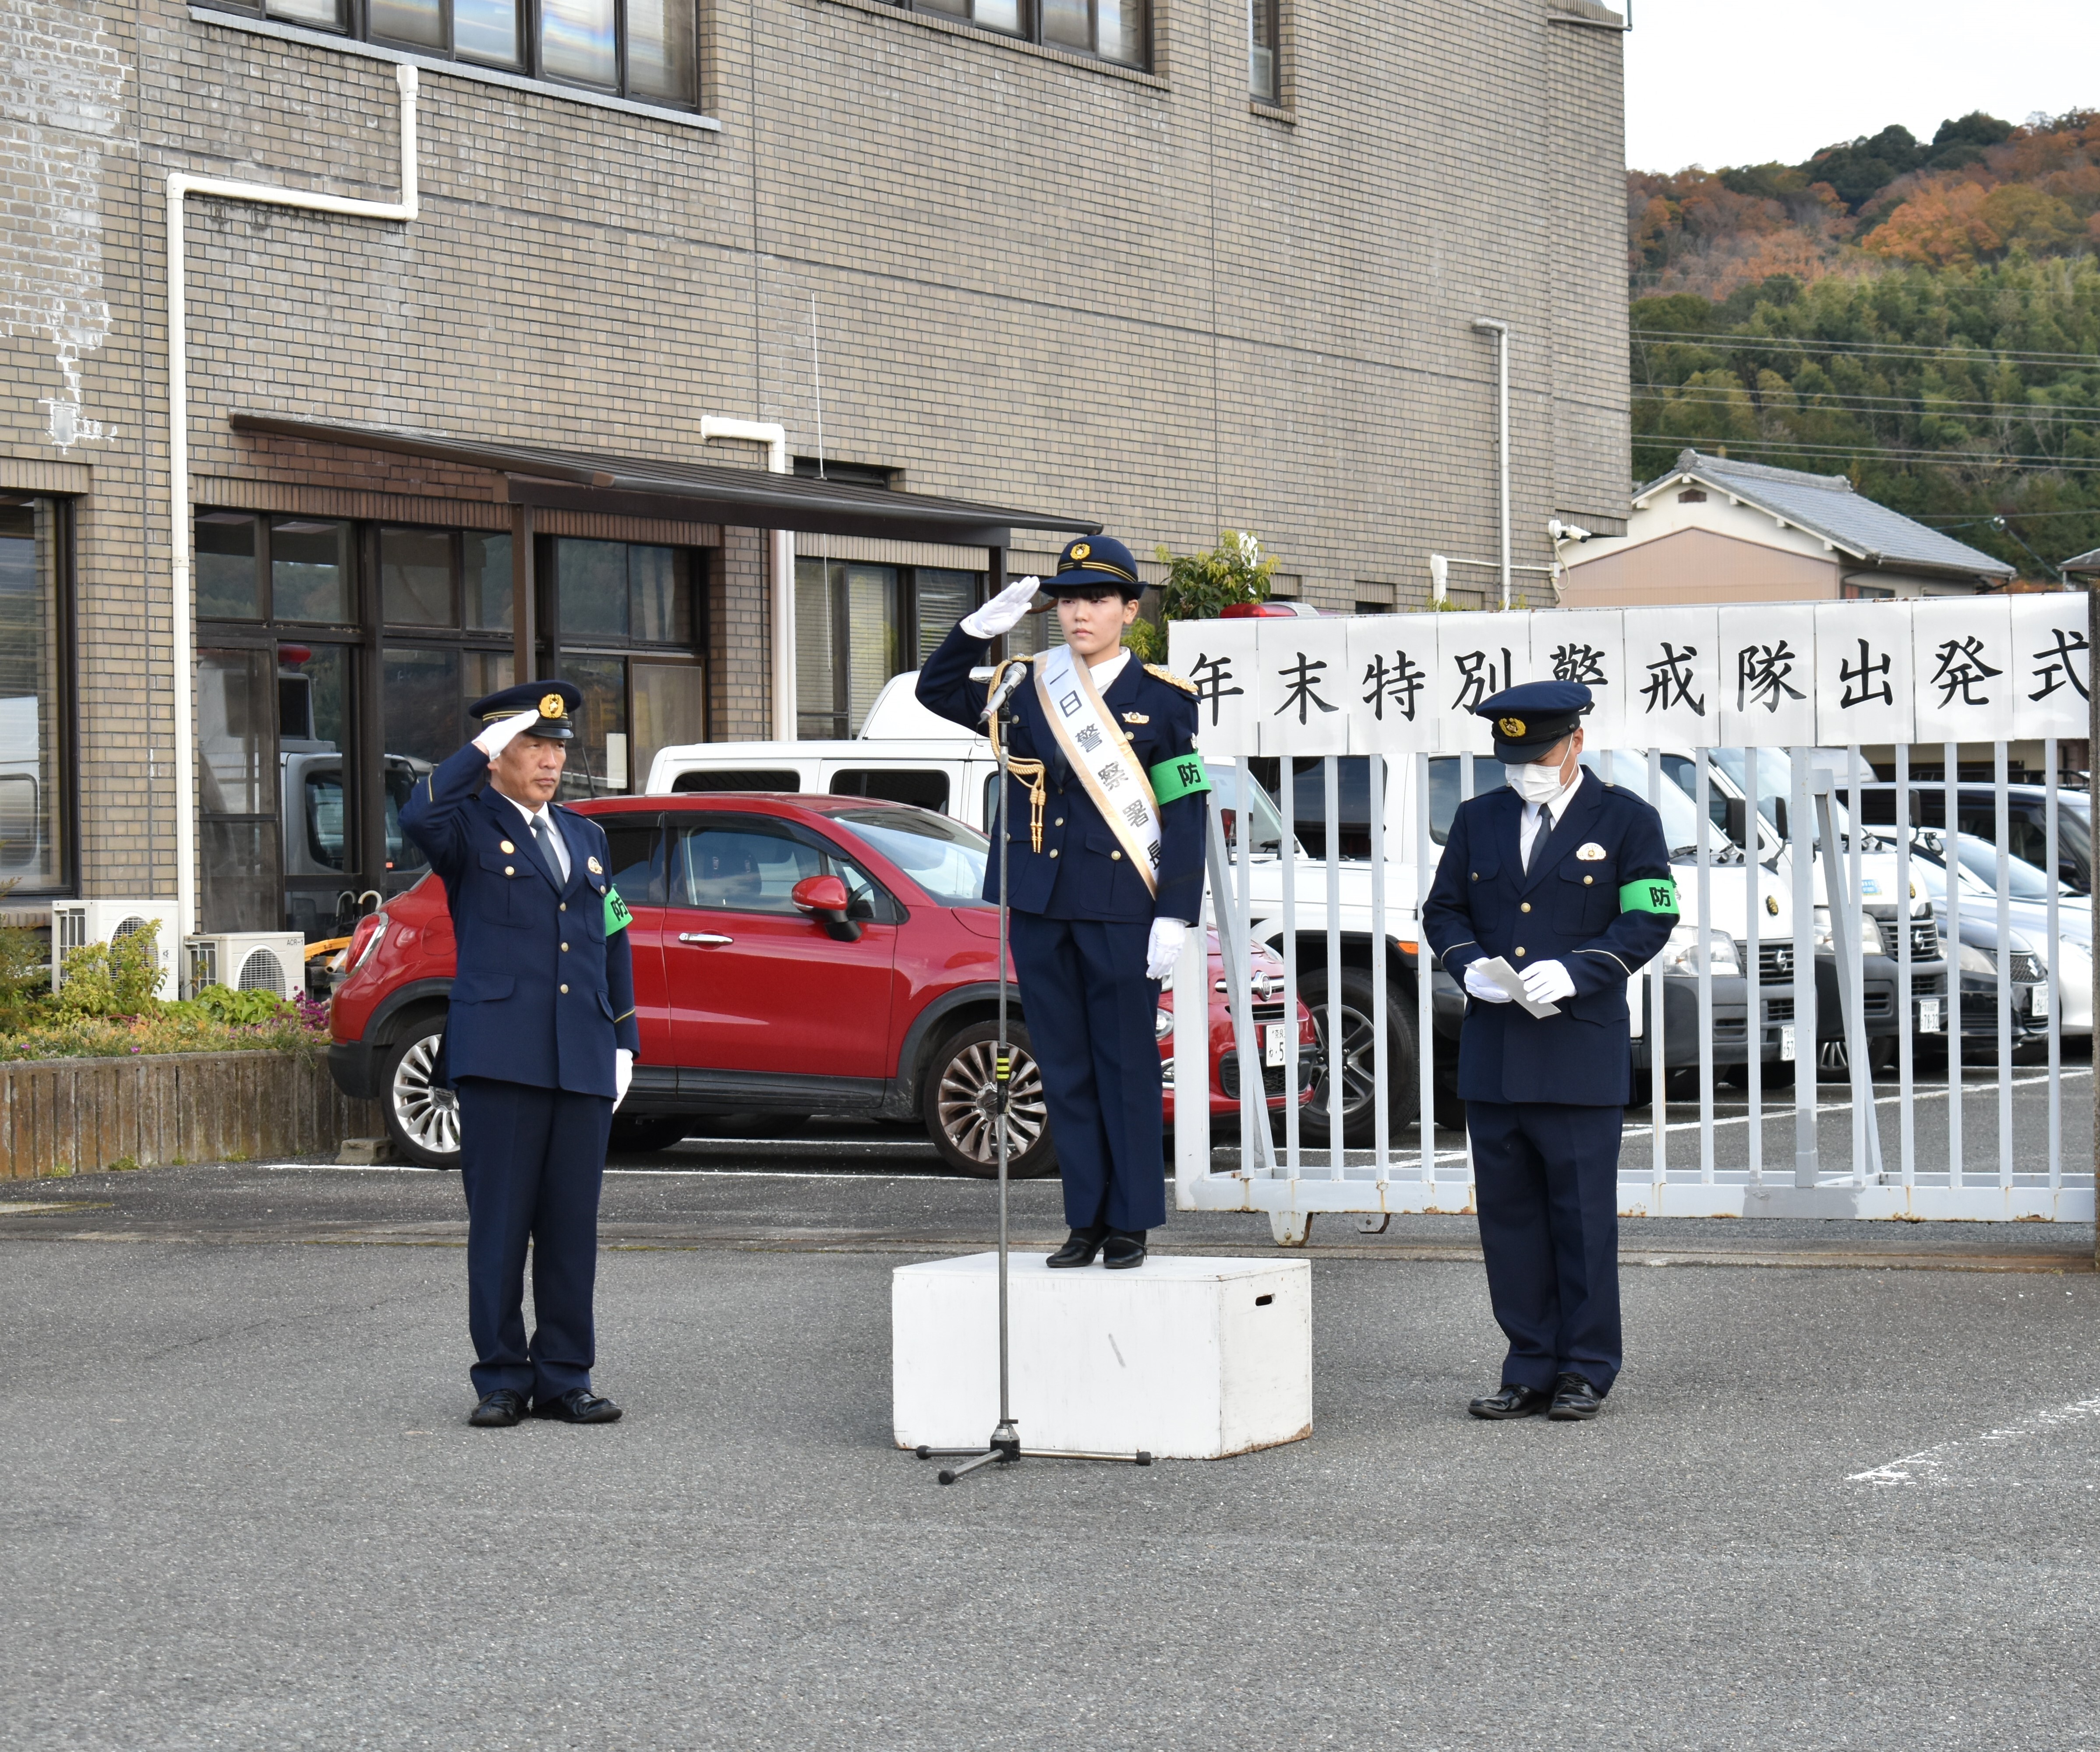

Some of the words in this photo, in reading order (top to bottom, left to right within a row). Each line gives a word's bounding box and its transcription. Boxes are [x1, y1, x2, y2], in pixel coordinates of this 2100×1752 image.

[1177, 762, 1201, 788] 防
[610, 896, 628, 922] 防
[1648, 886, 1671, 908] 防
[1275, 1028, 1285, 1038] 奈良
